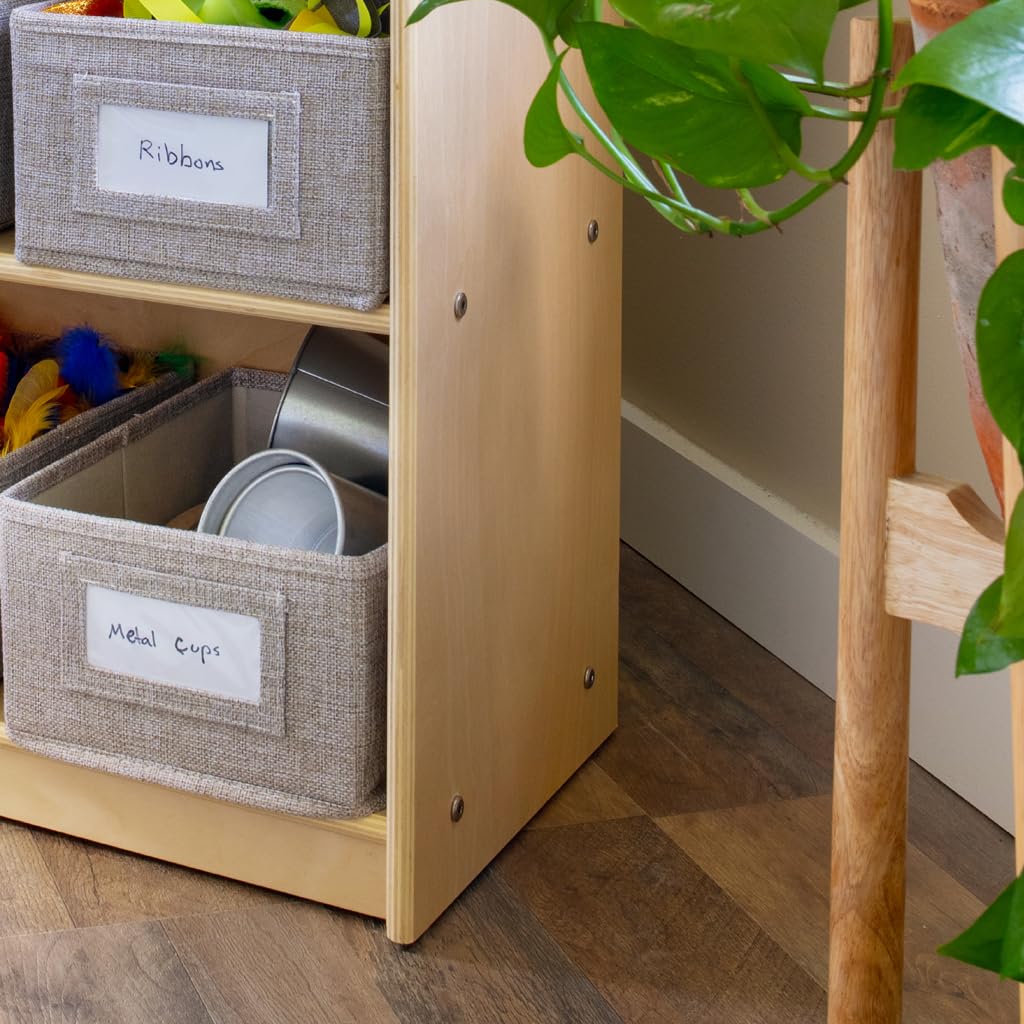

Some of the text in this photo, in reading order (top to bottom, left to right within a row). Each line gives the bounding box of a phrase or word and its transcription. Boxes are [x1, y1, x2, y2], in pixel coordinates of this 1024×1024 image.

[139, 138, 225, 172] Ribbons
[108, 623, 220, 664] Metal Cups
